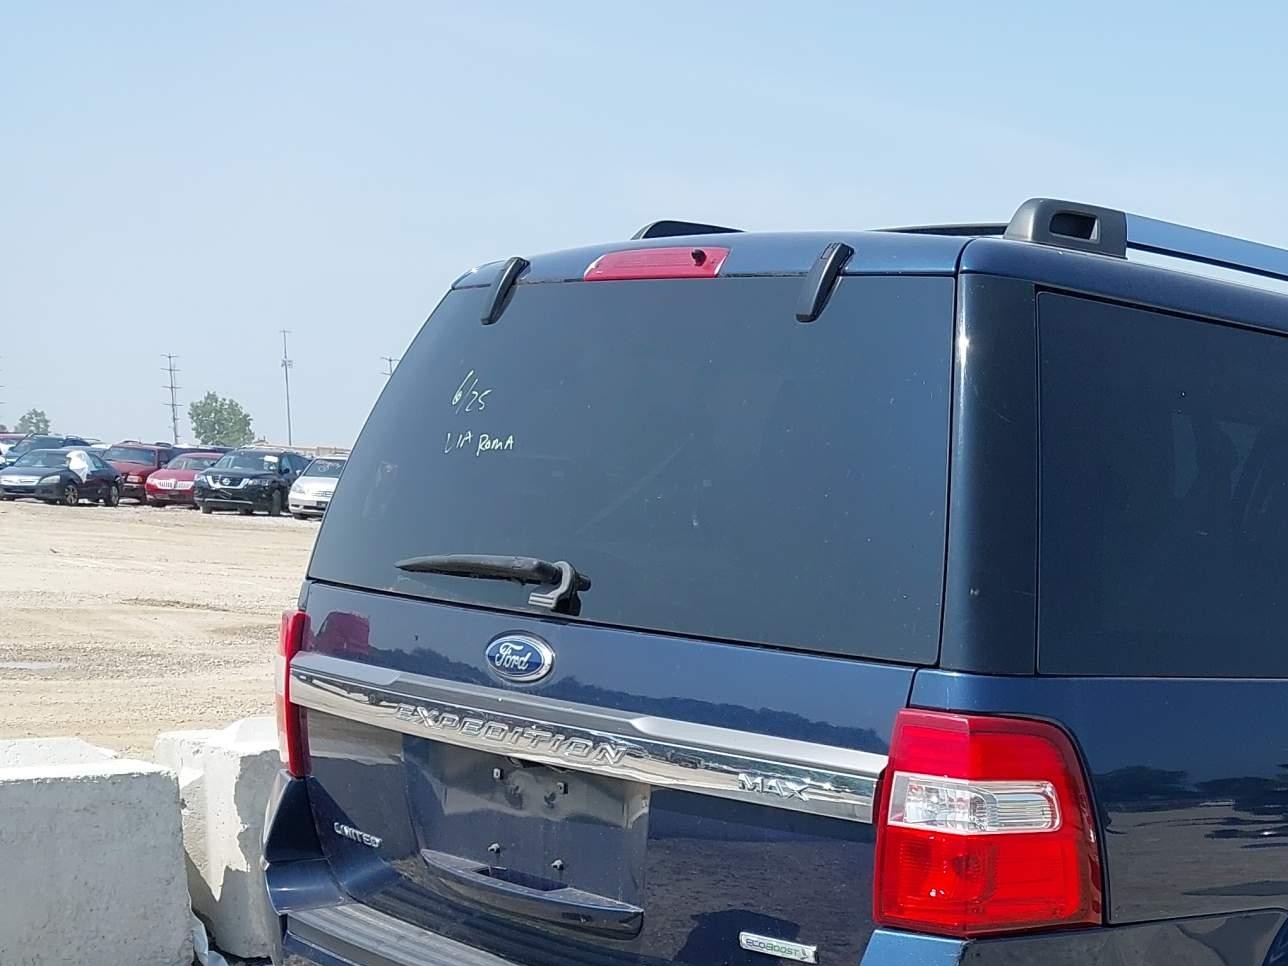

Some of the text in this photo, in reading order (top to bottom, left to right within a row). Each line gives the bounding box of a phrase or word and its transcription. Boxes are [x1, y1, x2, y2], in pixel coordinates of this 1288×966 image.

[495, 642, 534, 672] Ford
[396, 703, 629, 766] EXPEDITION
[737, 773, 811, 802] MAX
